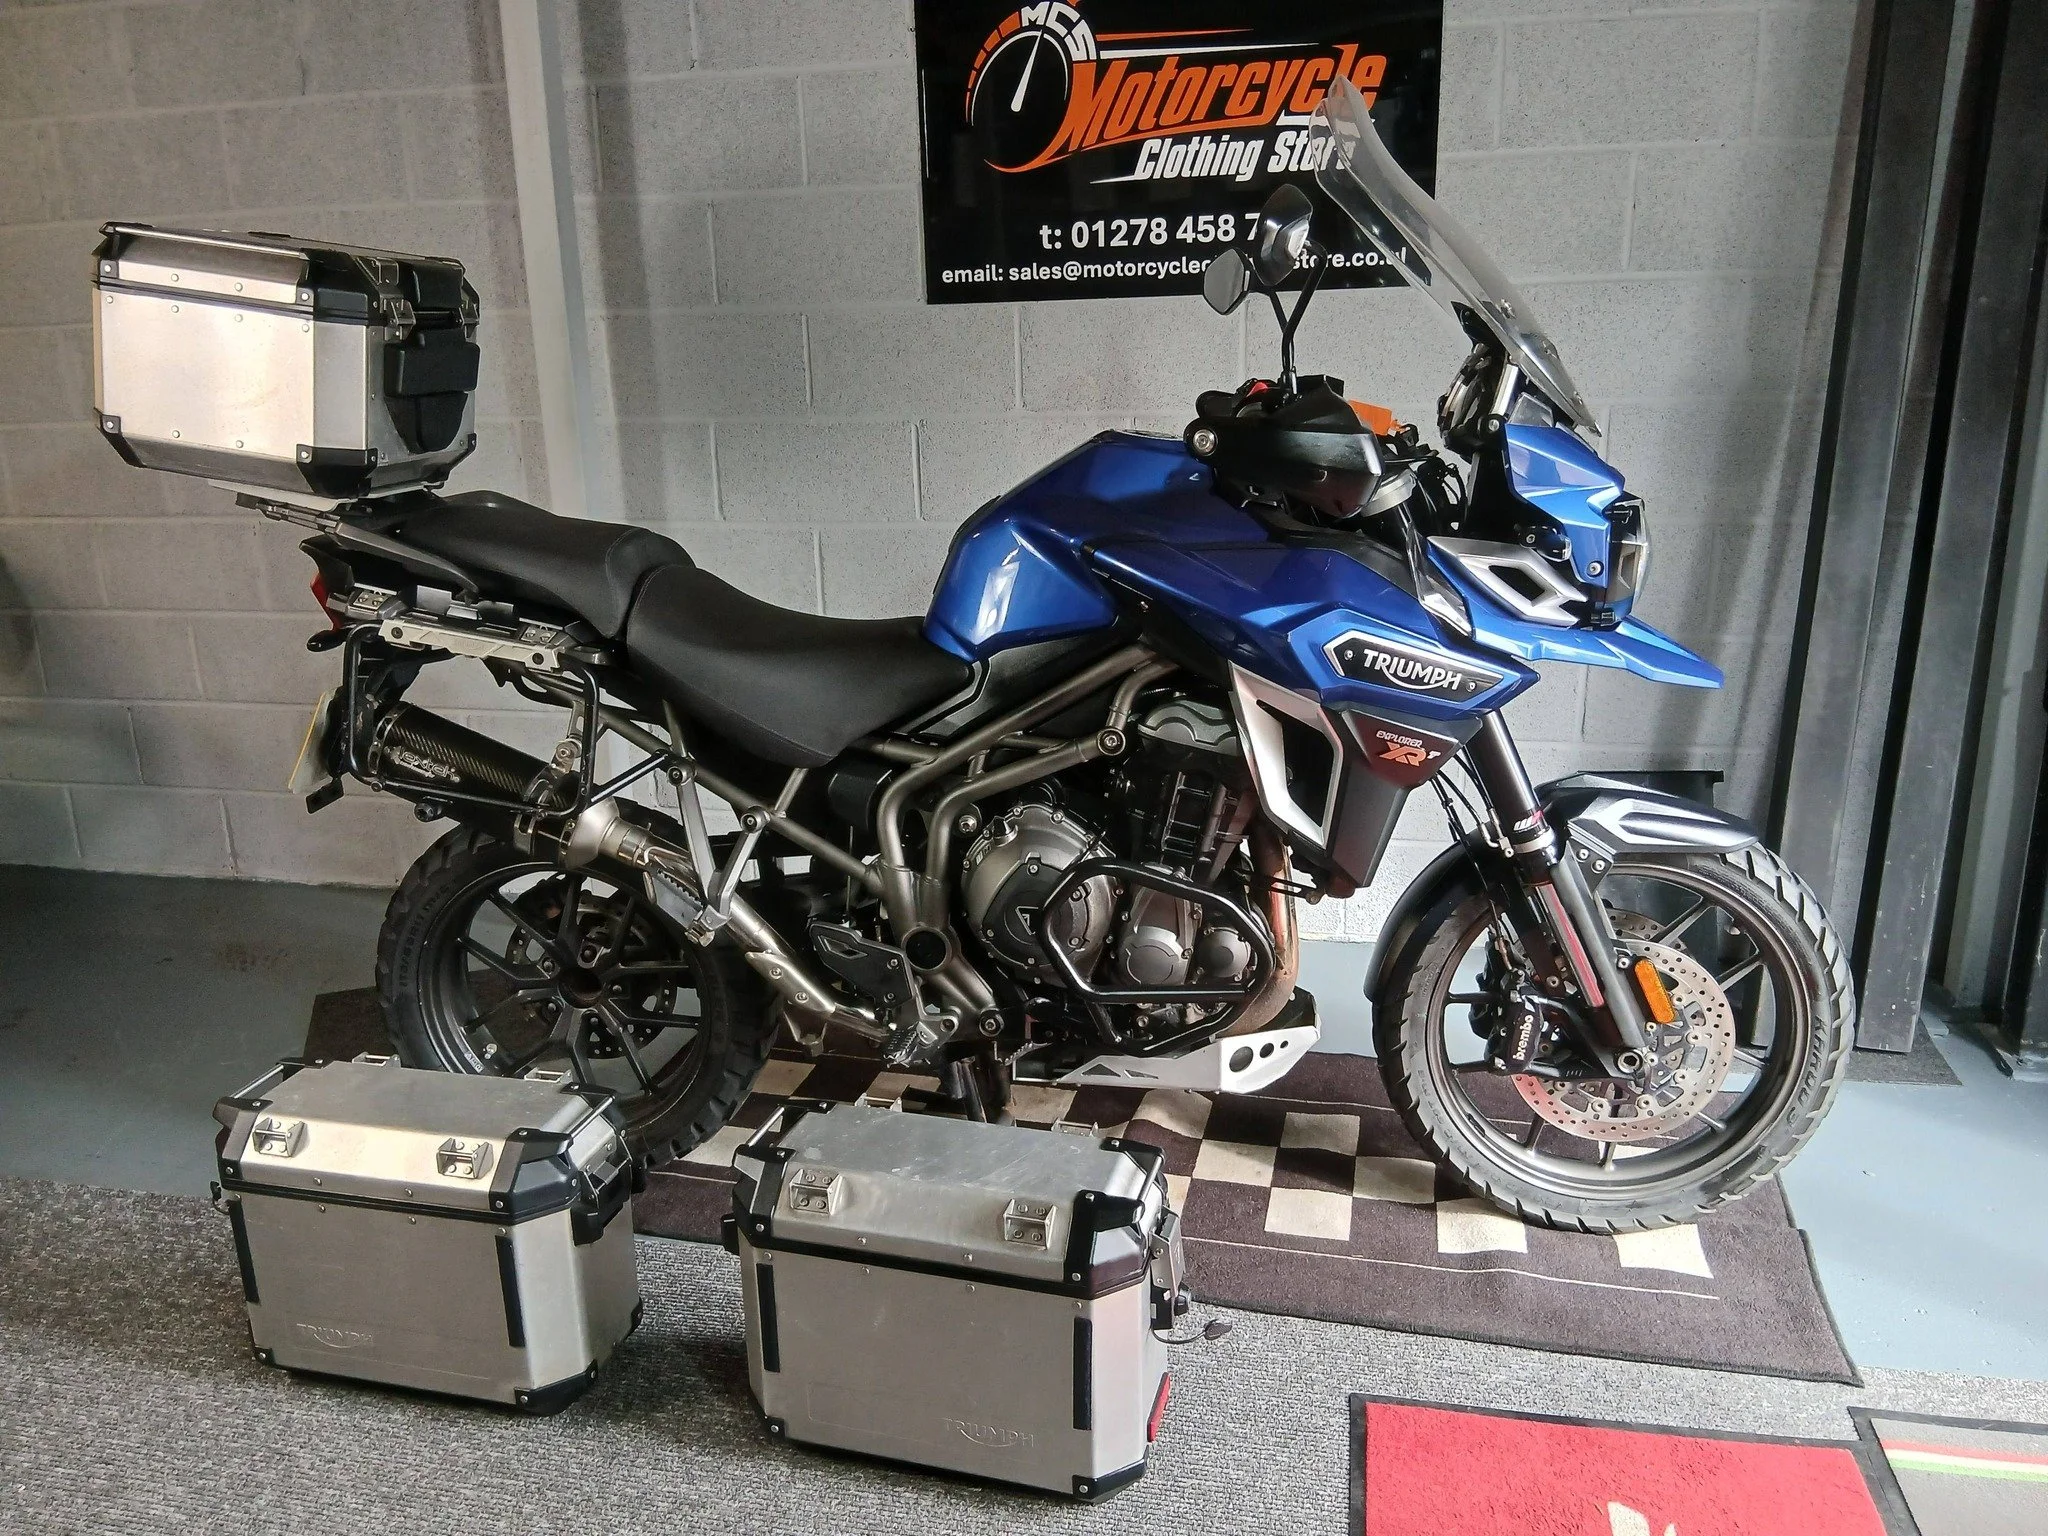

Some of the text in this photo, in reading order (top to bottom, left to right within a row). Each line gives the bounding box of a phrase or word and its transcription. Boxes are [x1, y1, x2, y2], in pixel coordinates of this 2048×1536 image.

[1021, 1, 1097, 61] MCS
[1062, 44, 1387, 152] Motorcycle
[1133, 132, 1264, 182] Clothing
[1039, 223, 1062, 250] t:
[1071, 217, 1169, 249] 01278
[1175, 214, 1236, 244] 458
[941, 263, 1004, 283] email:
[1363, 649, 1462, 691] TRIUMPH
[1376, 730, 1424, 749] EXPLORER
[1512, 1014, 1534, 1061] brembo
[940, 1417, 1035, 1448] TRIUMPH
